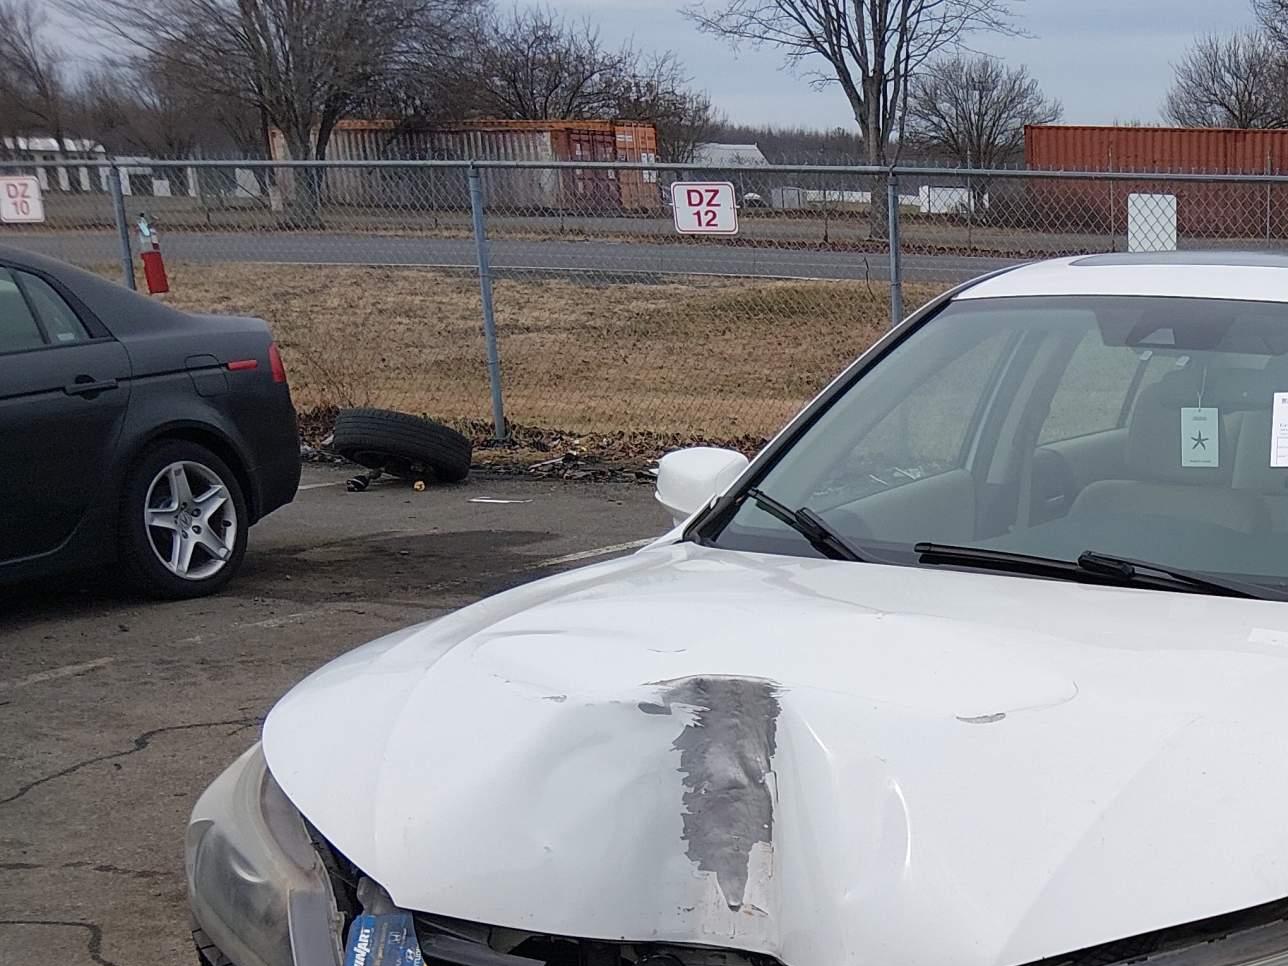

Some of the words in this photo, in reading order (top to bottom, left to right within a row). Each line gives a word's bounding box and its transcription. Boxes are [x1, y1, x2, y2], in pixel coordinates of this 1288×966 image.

[6, 182, 31, 198] DZ
[686, 189, 721, 207] DZ
[11, 200, 30, 215] 10
[692, 209, 718, 227] 12
